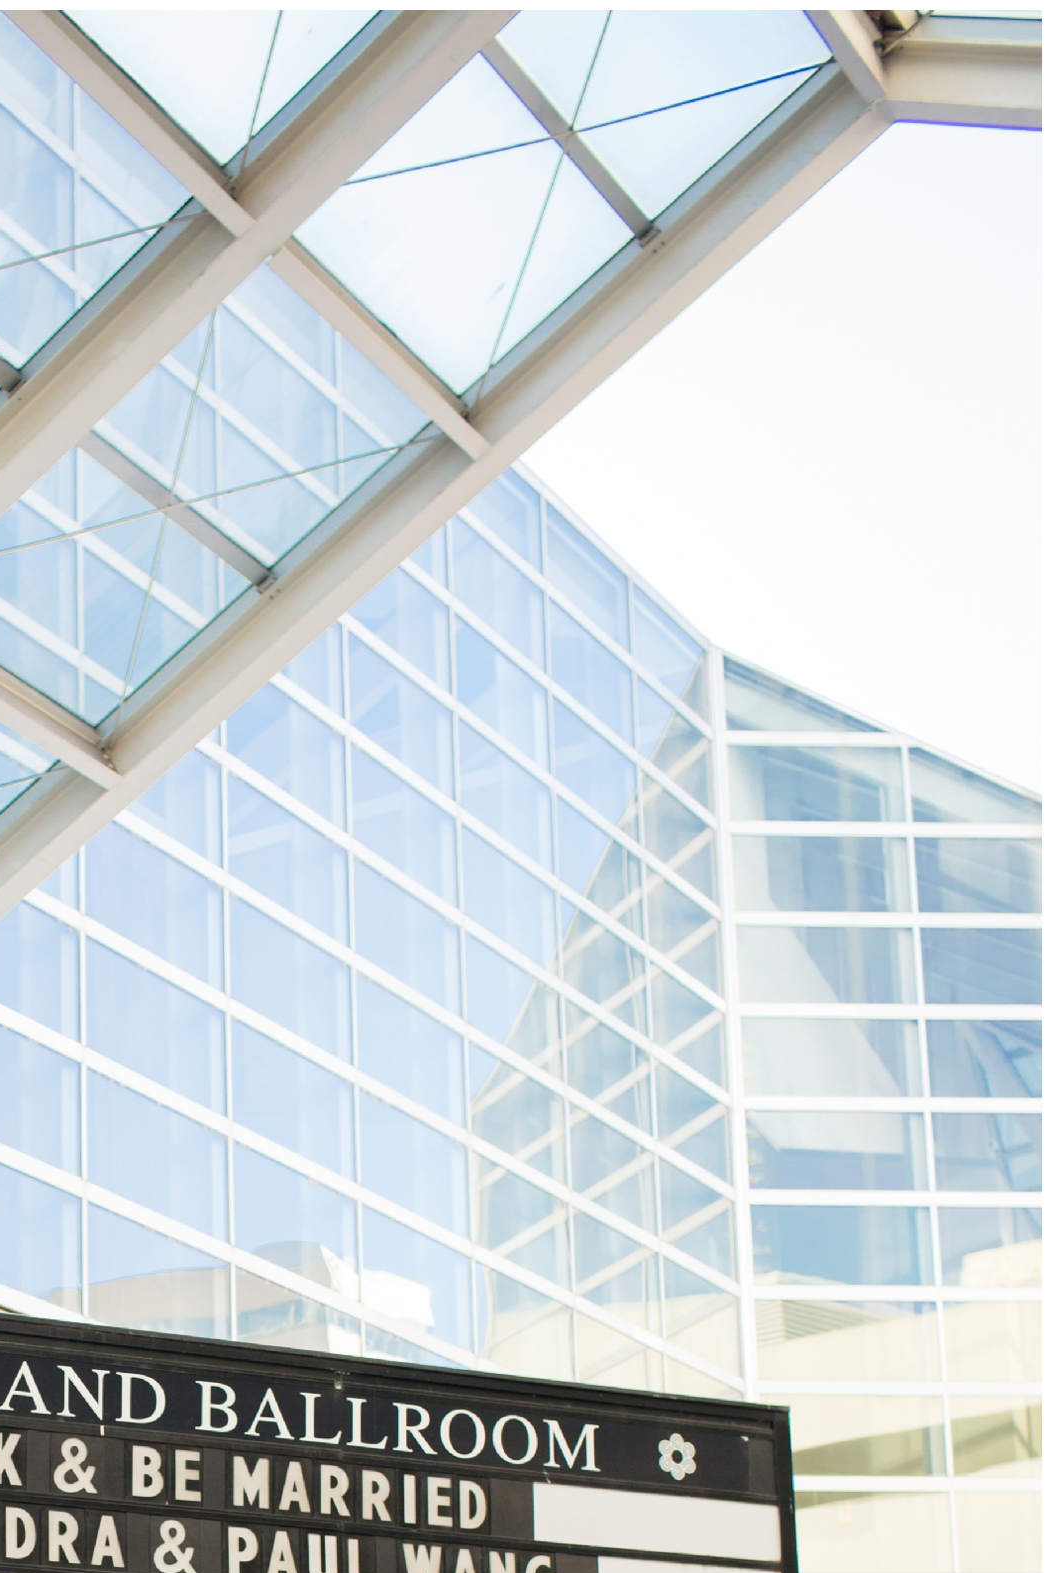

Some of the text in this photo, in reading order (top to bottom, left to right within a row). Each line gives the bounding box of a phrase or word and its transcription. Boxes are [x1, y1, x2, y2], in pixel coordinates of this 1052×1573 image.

[194, 1380, 601, 1473] BALLROOM
[53, 1437, 98, 1494] &
[131, 1445, 202, 1503] BE
[231, 1455, 488, 1531] MARRIED
